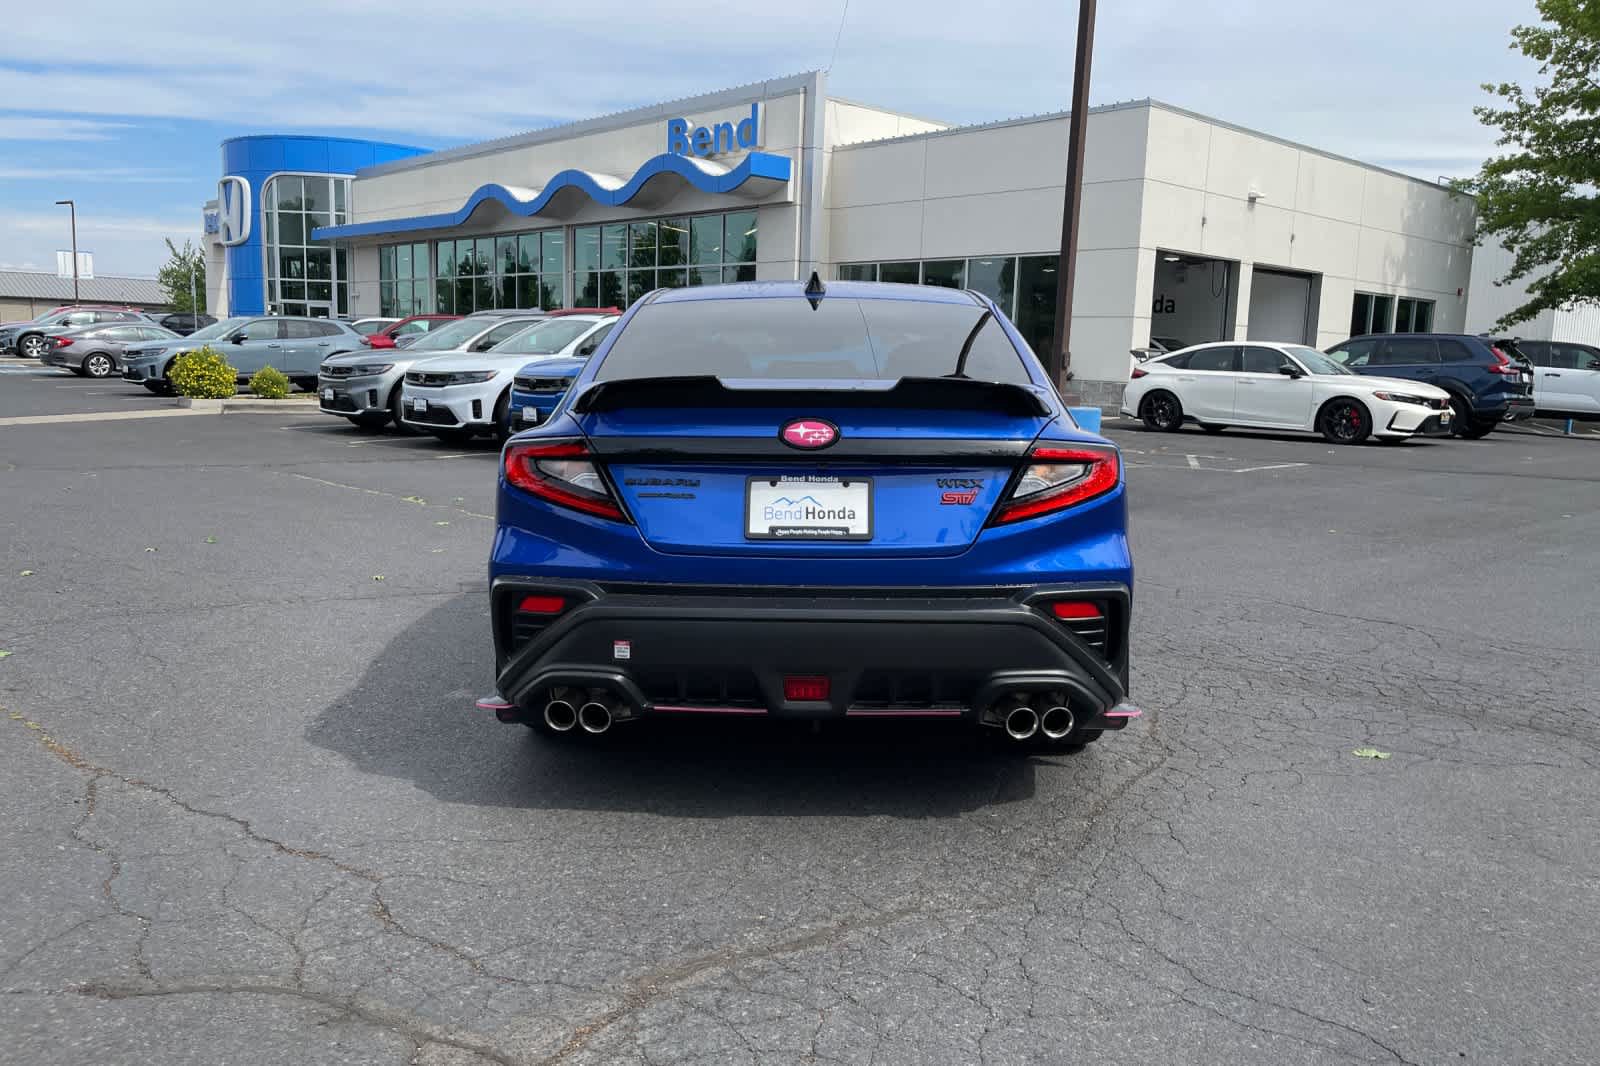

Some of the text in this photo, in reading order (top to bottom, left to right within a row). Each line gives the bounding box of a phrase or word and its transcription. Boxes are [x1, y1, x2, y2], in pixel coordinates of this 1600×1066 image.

[667, 102, 758, 156] Bend
[624, 478, 701, 487] SUBARU
[808, 475, 839, 483] Honda
[936, 478, 984, 489] WRX
